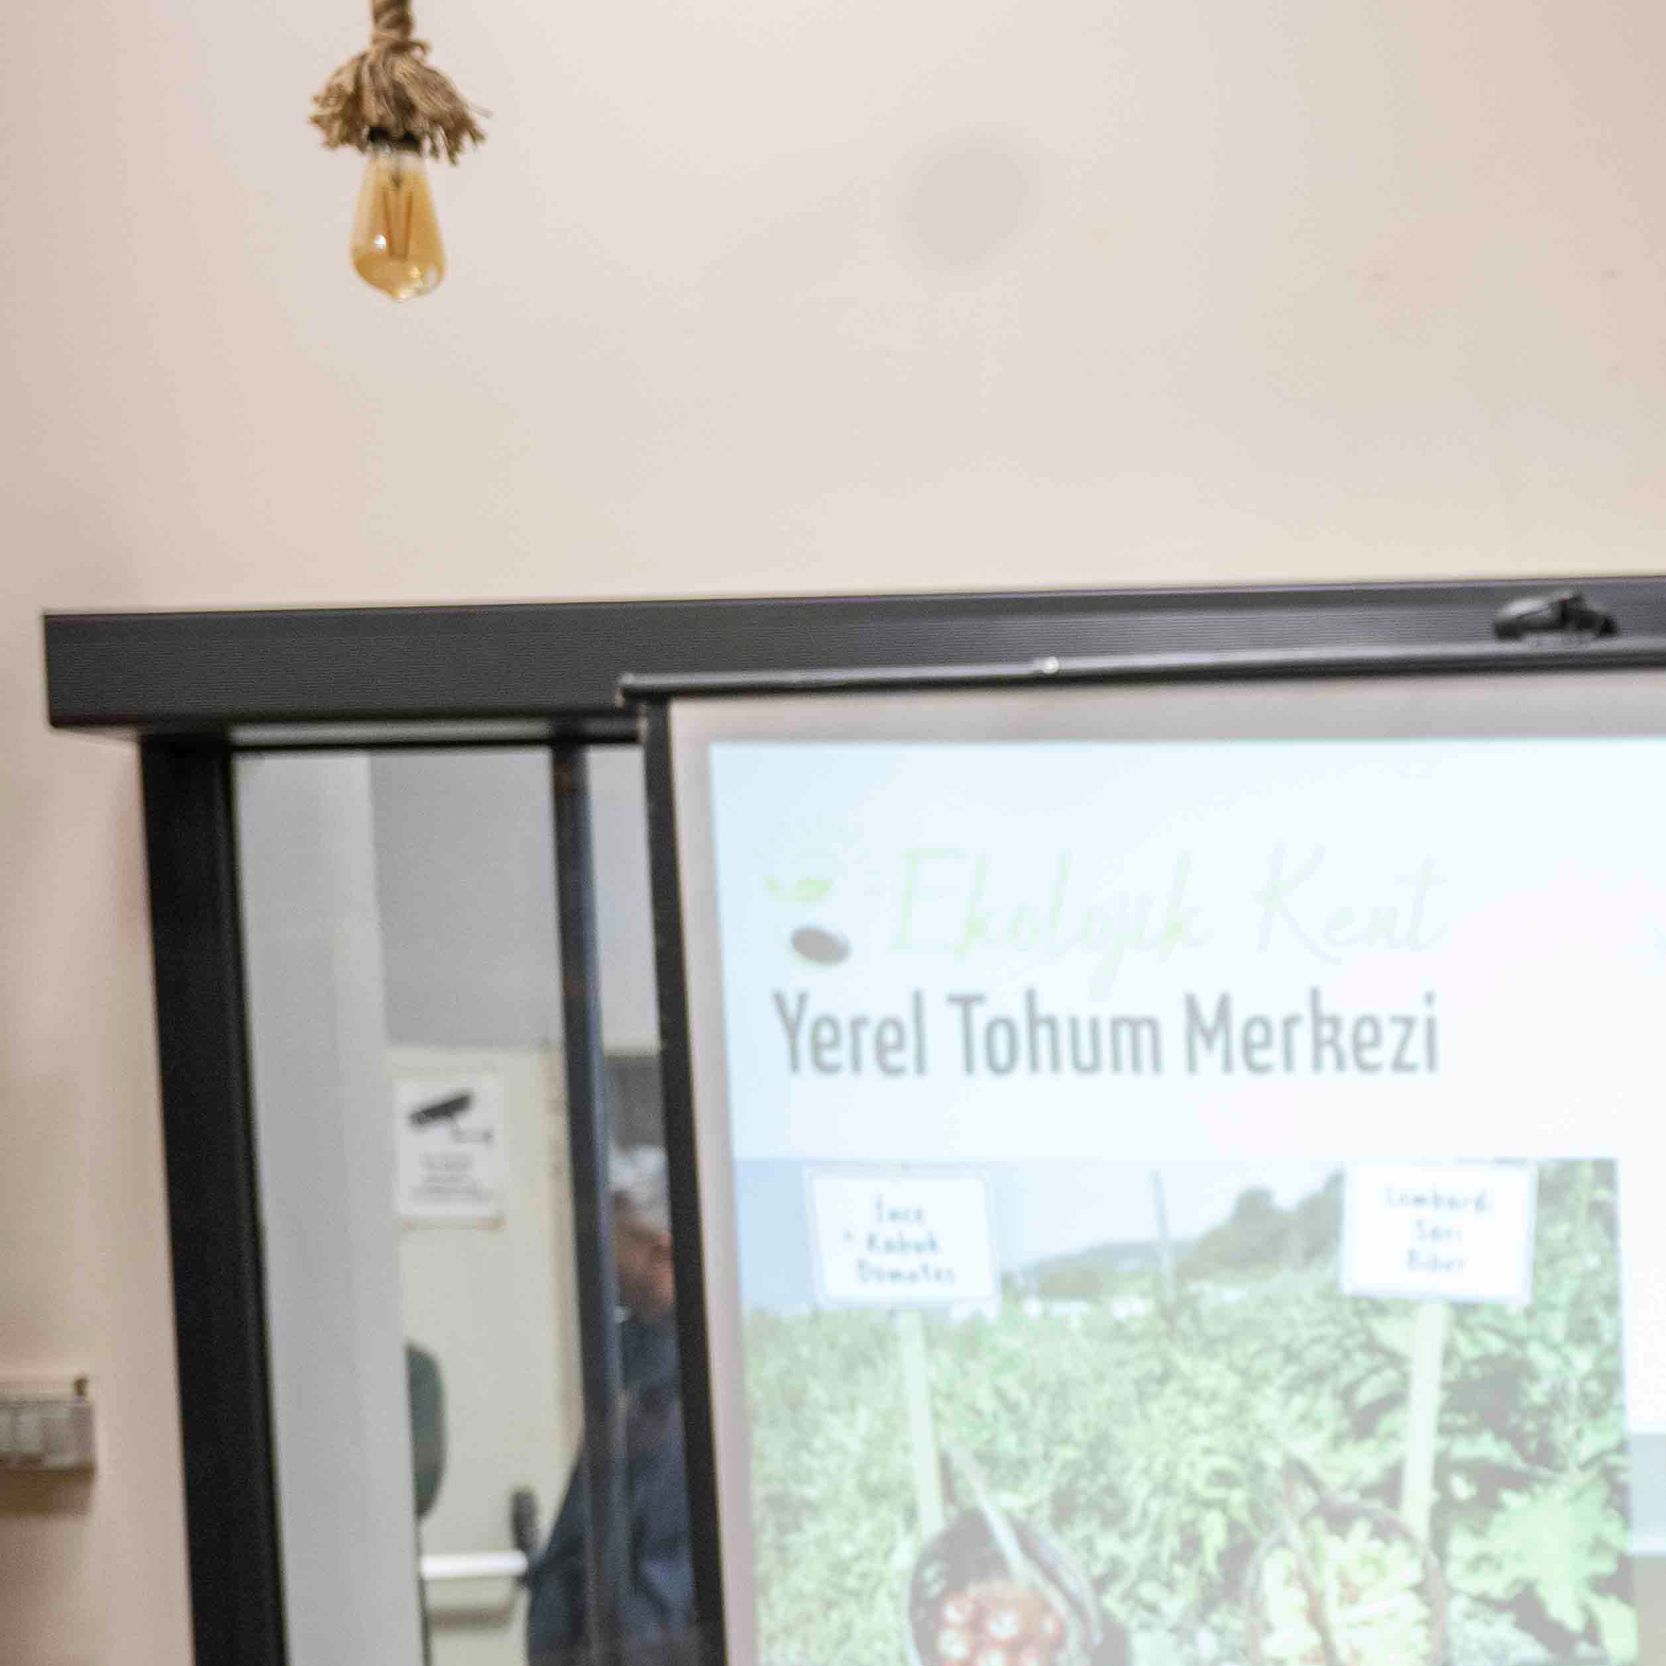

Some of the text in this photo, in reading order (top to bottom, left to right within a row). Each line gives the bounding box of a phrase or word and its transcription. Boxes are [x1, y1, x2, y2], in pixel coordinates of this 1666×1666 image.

[771, 988, 1441, 1077] Yerel Tohum Merkezi
